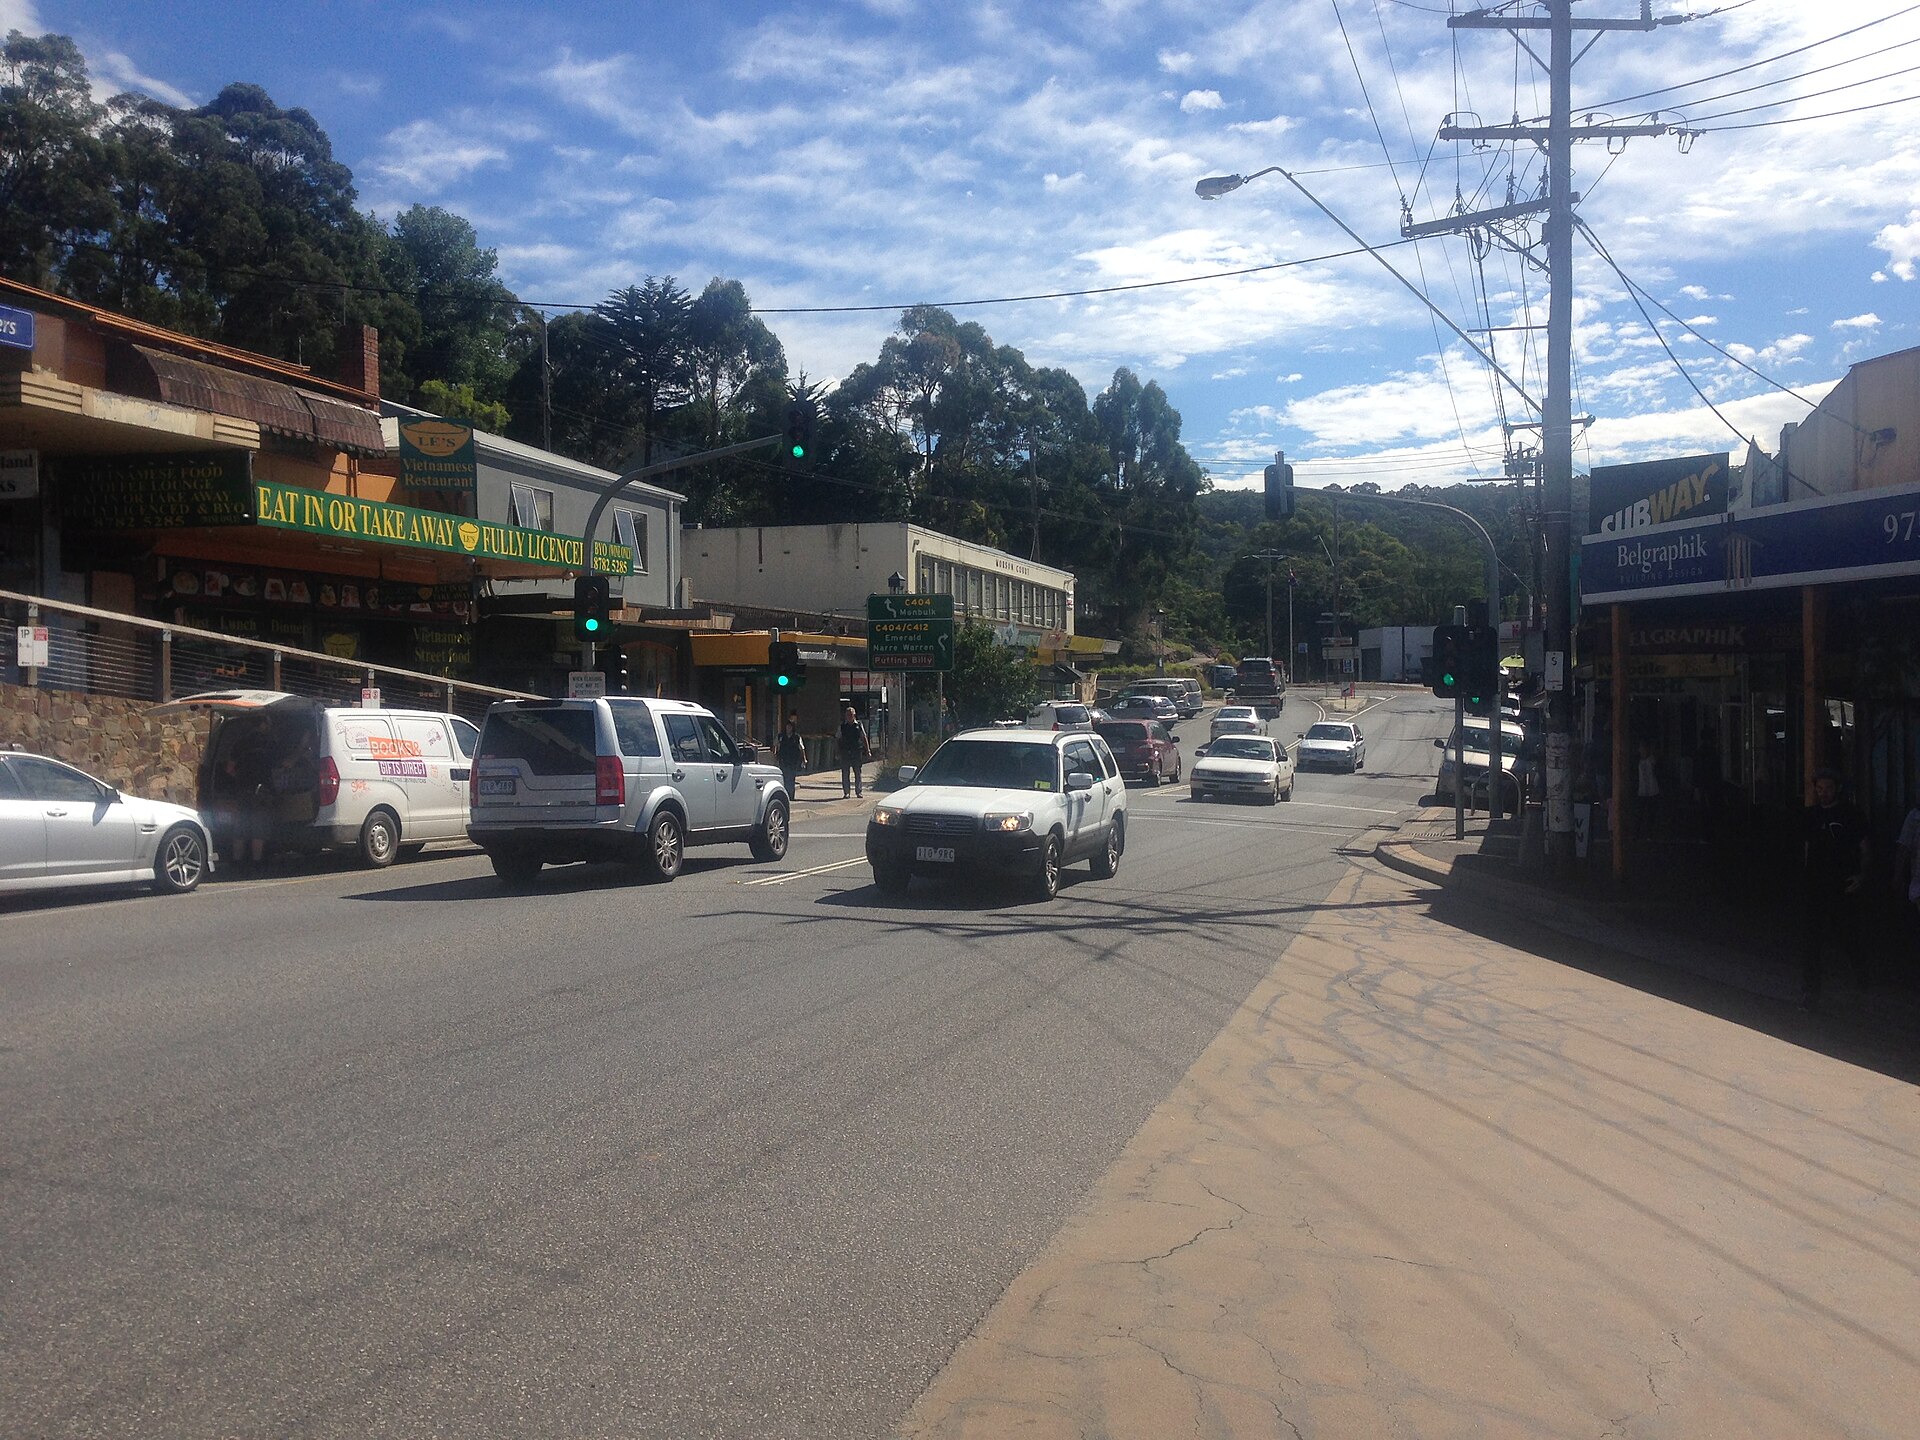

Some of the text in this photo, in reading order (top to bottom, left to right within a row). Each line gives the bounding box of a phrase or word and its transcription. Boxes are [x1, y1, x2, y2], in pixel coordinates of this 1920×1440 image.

[418, 436, 456, 448] LE'S
[181, 465, 224, 477] FOOD
[403, 458, 474, 472] Vietnamese
[150, 479, 214, 492] LOUNGE
[404, 473, 473, 487] Restaurant
[123, 494, 144, 504] OR
[149, 492, 187, 504] TAKE
[191, 490, 232, 503] AWAY
[1600, 462, 1719, 534] SUBWAY
[196, 504, 208, 514] &
[213, 502, 246, 514] BYO
[144, 515, 185, 528] 5285
[258, 487, 456, 547] EAT IN OR TAKE AWAY
[482, 526, 524, 558] FULLY
[594, 542, 608, 556] BYO
[1617, 534, 1707, 573] Belgraphik
[594, 556, 628, 574] 8782 5285
[1668, 568, 1703, 579] DESIGN
[21, 629, 30, 638] 1P
[876, 624, 928, 632] C404/C412
[414, 627, 472, 644] Vietnamese
[415, 647, 445, 662] Street
[912, 656, 933, 664] Billy
[371, 740, 411, 756] BOOKS
[413, 740, 422, 754] &
[380, 762, 401, 775] GIFTS
[402, 762, 426, 776] DIRECT
